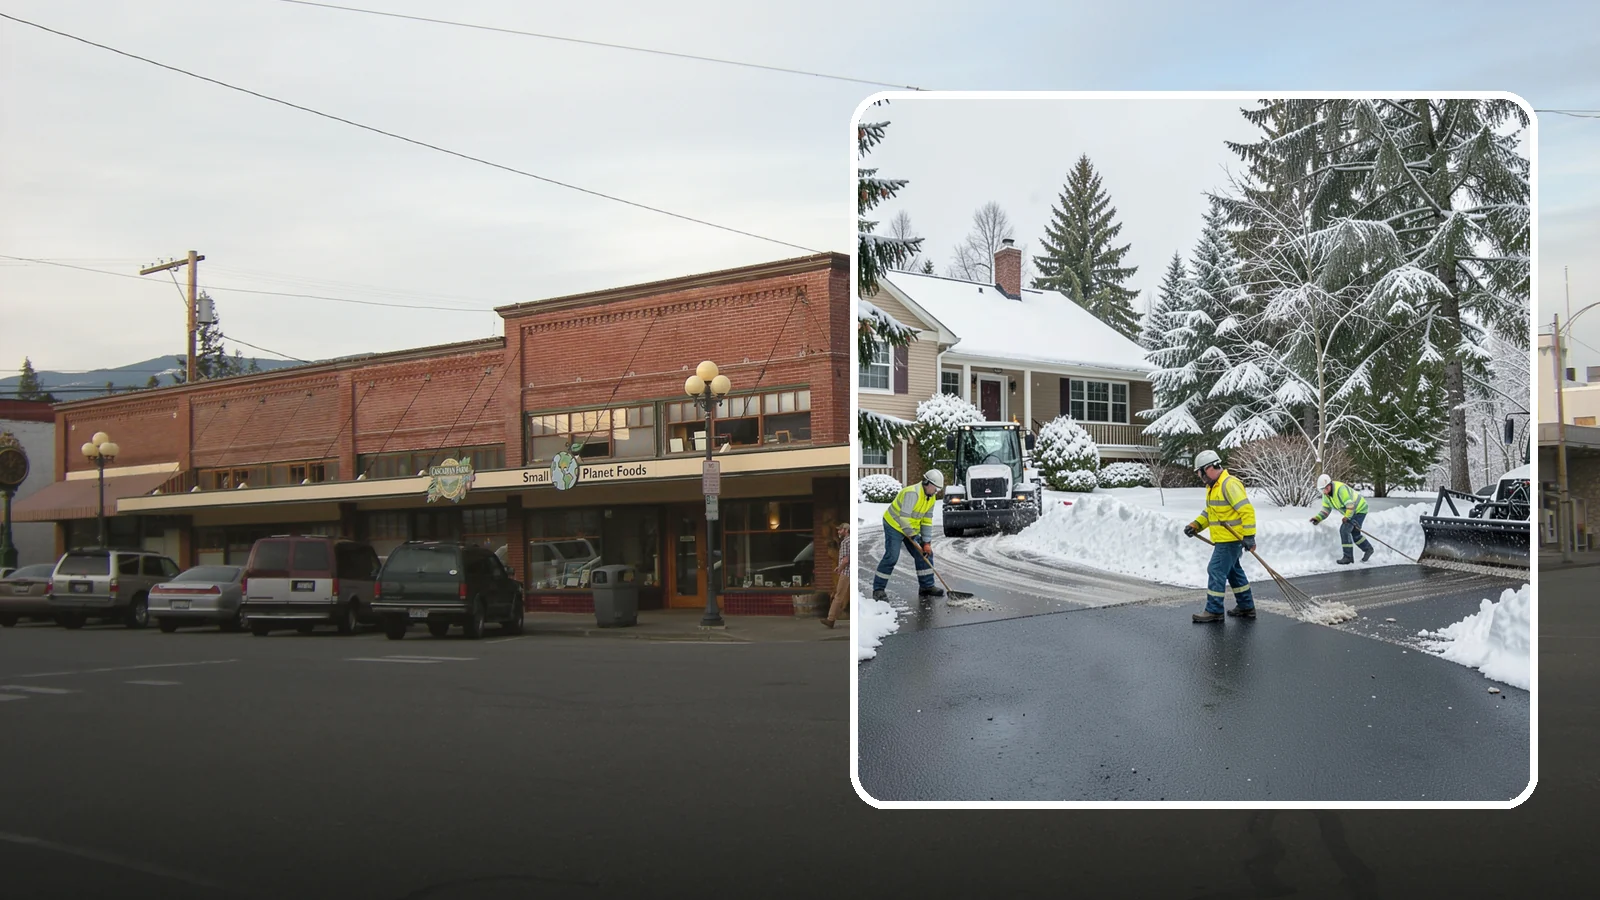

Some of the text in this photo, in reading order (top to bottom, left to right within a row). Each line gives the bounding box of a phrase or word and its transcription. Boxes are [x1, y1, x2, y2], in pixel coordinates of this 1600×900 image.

[523, 464, 647, 482] Small Planet Foods
